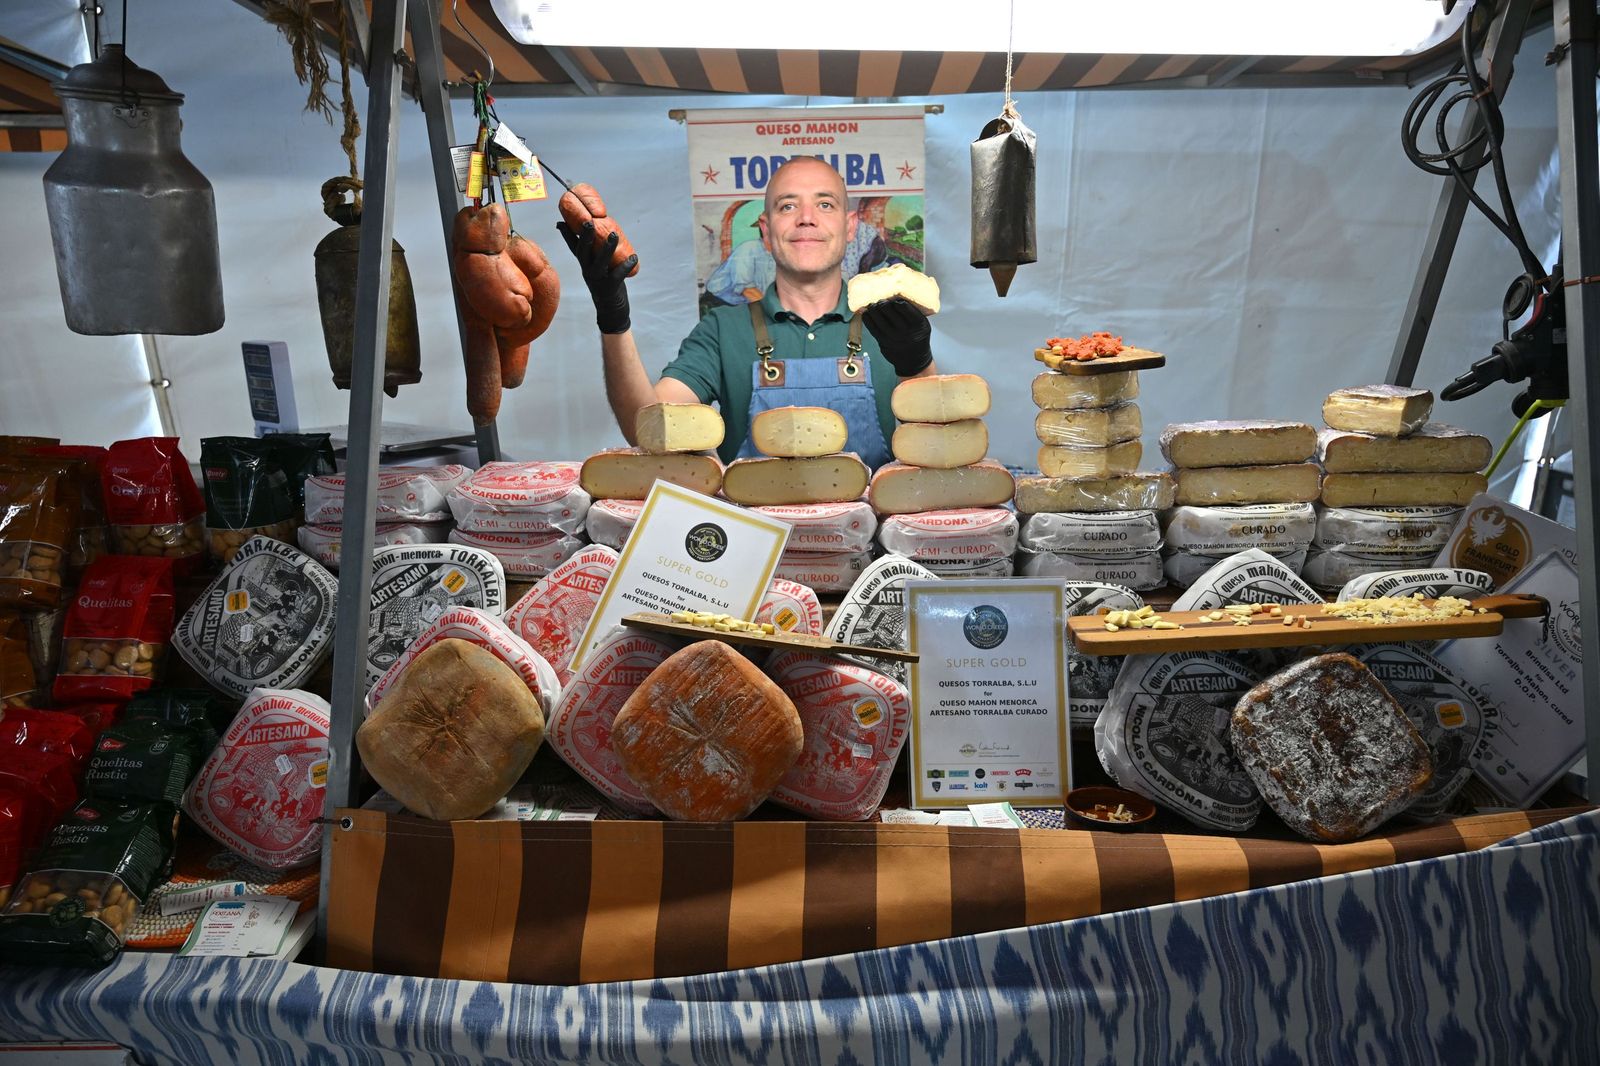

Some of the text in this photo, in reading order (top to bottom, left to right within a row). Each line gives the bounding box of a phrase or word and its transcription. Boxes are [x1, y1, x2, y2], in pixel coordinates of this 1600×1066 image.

[756, 122, 859, 136] QUESO MAHON
[782, 137, 835, 146] ARTESANO
[472, 490, 528, 500] CARDONA
[761, 506, 818, 514] CARDONA
[474, 520, 499, 528] SEMI
[1242, 525, 1286, 534] CURADO
[1387, 529, 1433, 538] CURADO
[800, 535, 843, 543] CURADO
[1084, 532, 1127, 541] CURADO
[229, 539, 301, 568] TORRALBA
[915, 547, 940, 556] SEMI
[1496, 542, 1520, 557] GOLD
[1465, 546, 1517, 573] FRANKFURT
[450, 549, 500, 608] TORRALBA
[552, 561, 578, 579] queso
[656, 555, 729, 589] SUPER GOLD
[796, 574, 839, 583] CURADO
[1095, 571, 1137, 580] CURADO
[370, 563, 429, 607] ARTESANO
[567, 574, 605, 593] ARTES
[642, 571, 729, 609] QUESOS TORRALBA, S.L.U
[859, 575, 882, 601] queso
[1221, 574, 1246, 593] queso
[79, 595, 134, 609] Quelitas
[621, 592, 659, 610] ARTESANO
[634, 587, 659, 601] QUESO
[660, 596, 686, 611] MAHON
[200, 588, 226, 651] ARTESANO
[415, 625, 437, 648] queso
[1563, 628, 1582, 651] AWARD
[590, 654, 614, 680] queso
[946, 657, 1027, 668] SUPER GOLD
[1371, 663, 1435, 681] RTESANO
[1149, 664, 1172, 690] queso
[1525, 650, 1570, 695] Brindisa Ltd
[1535, 673, 1544, 683] for
[973, 680, 1015, 688] TORRALBA,
[1170, 676, 1238, 693] ARTESANO
[1494, 644, 1574, 726] Torralba Mahon, cured
[1514, 678, 1537, 703] D.O.P.
[865, 671, 908, 749] TORRALBA
[1015, 708, 1048, 716] CURADO
[1458, 678, 1499, 761] TORRALBA
[227, 716, 250, 743] queso
[244, 724, 310, 744] ARTESANO
[91, 757, 144, 768] Quelitas
[1131, 704, 1203, 810] NICOLÁS CARDONA
[86, 769, 128, 780] Rustic
[563, 749, 614, 795] CARDONA
[201, 813, 249, 855] CARDONA
